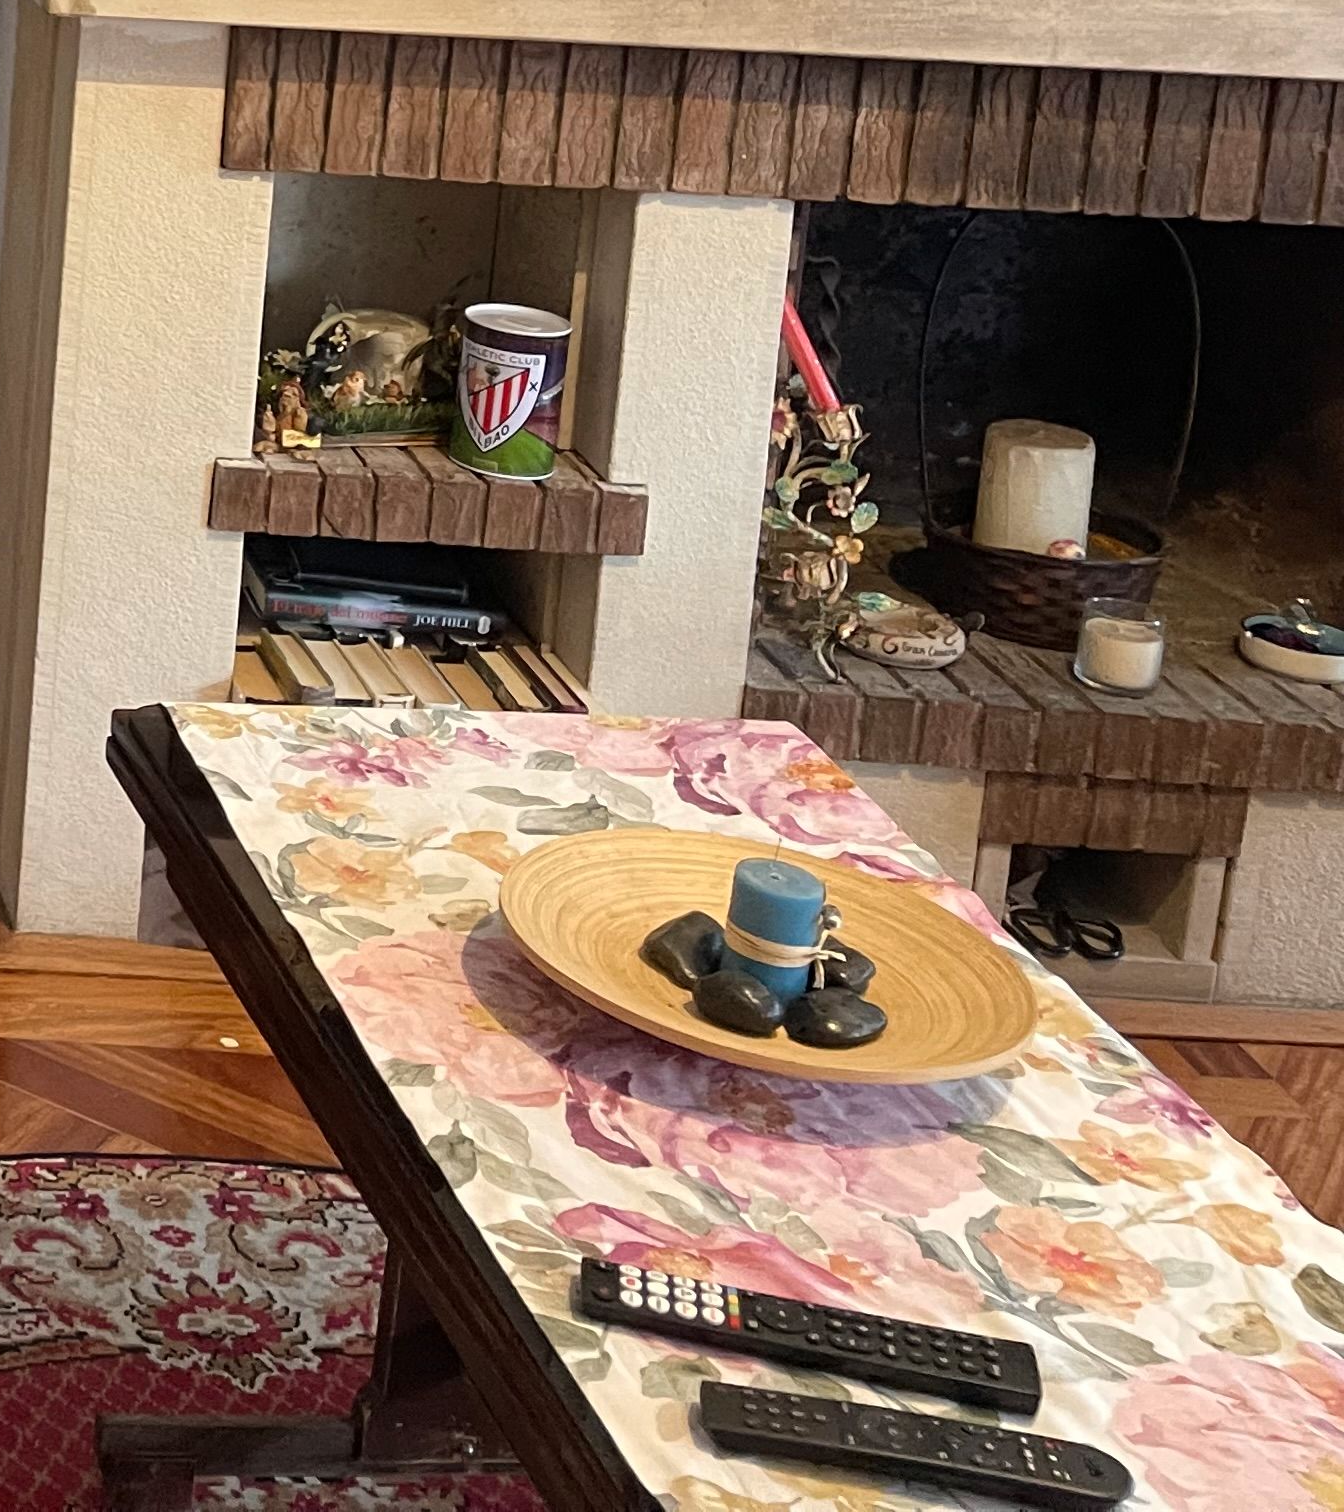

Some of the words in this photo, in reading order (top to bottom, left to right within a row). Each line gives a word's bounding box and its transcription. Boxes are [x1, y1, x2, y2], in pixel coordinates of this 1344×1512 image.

[509, 356, 541, 366] CLUB
[469, 417, 510, 448] BILBAO
[413, 614, 439, 627] JOE
[442, 616, 470, 629] HILL
